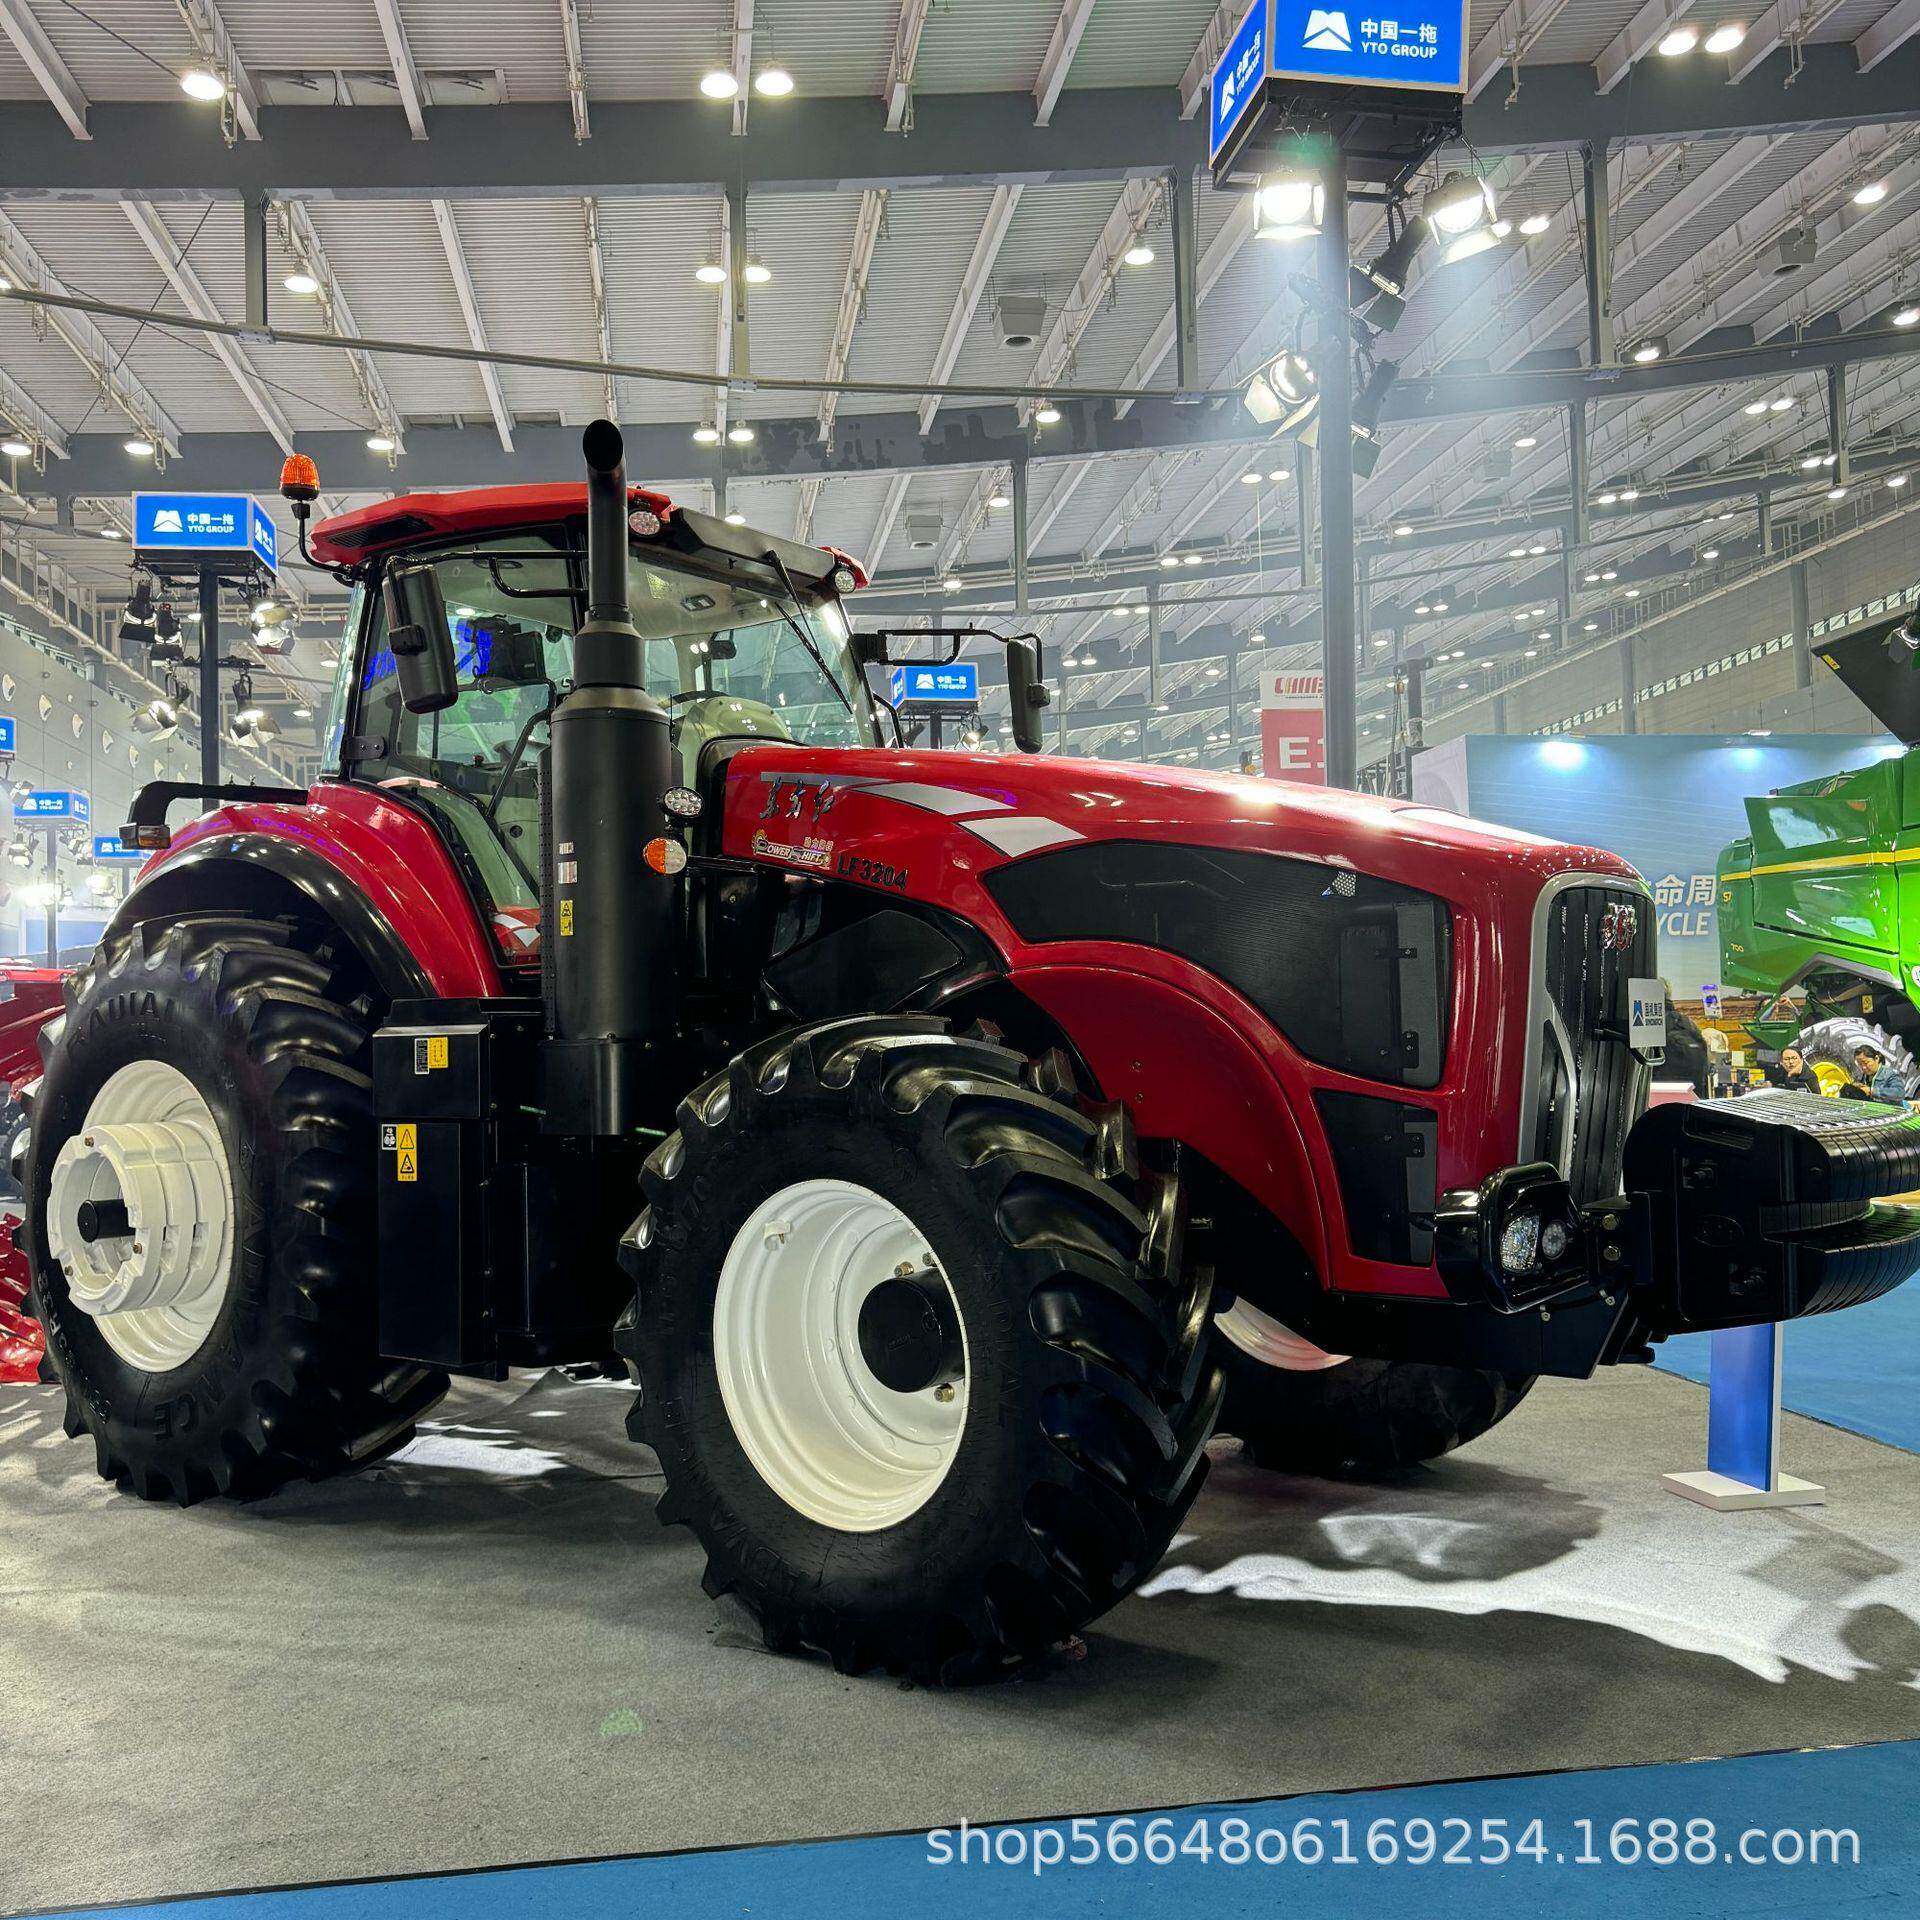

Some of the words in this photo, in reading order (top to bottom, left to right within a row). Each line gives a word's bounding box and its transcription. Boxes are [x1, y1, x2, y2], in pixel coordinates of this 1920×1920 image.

[1360, 18, 1438, 43] 中国一拖
[1361, 42, 1388, 55] YTO
[1391, 44, 1438, 59] GROUP
[187, 513, 234, 525] 中国一拖
[188, 525, 205, 533] YTO
[206, 525, 234, 534] GROUP
[837, 853, 910, 890] LF3204
[1655, 874, 1717, 907] 命周
[1656, 912, 1712, 937] YCLE
